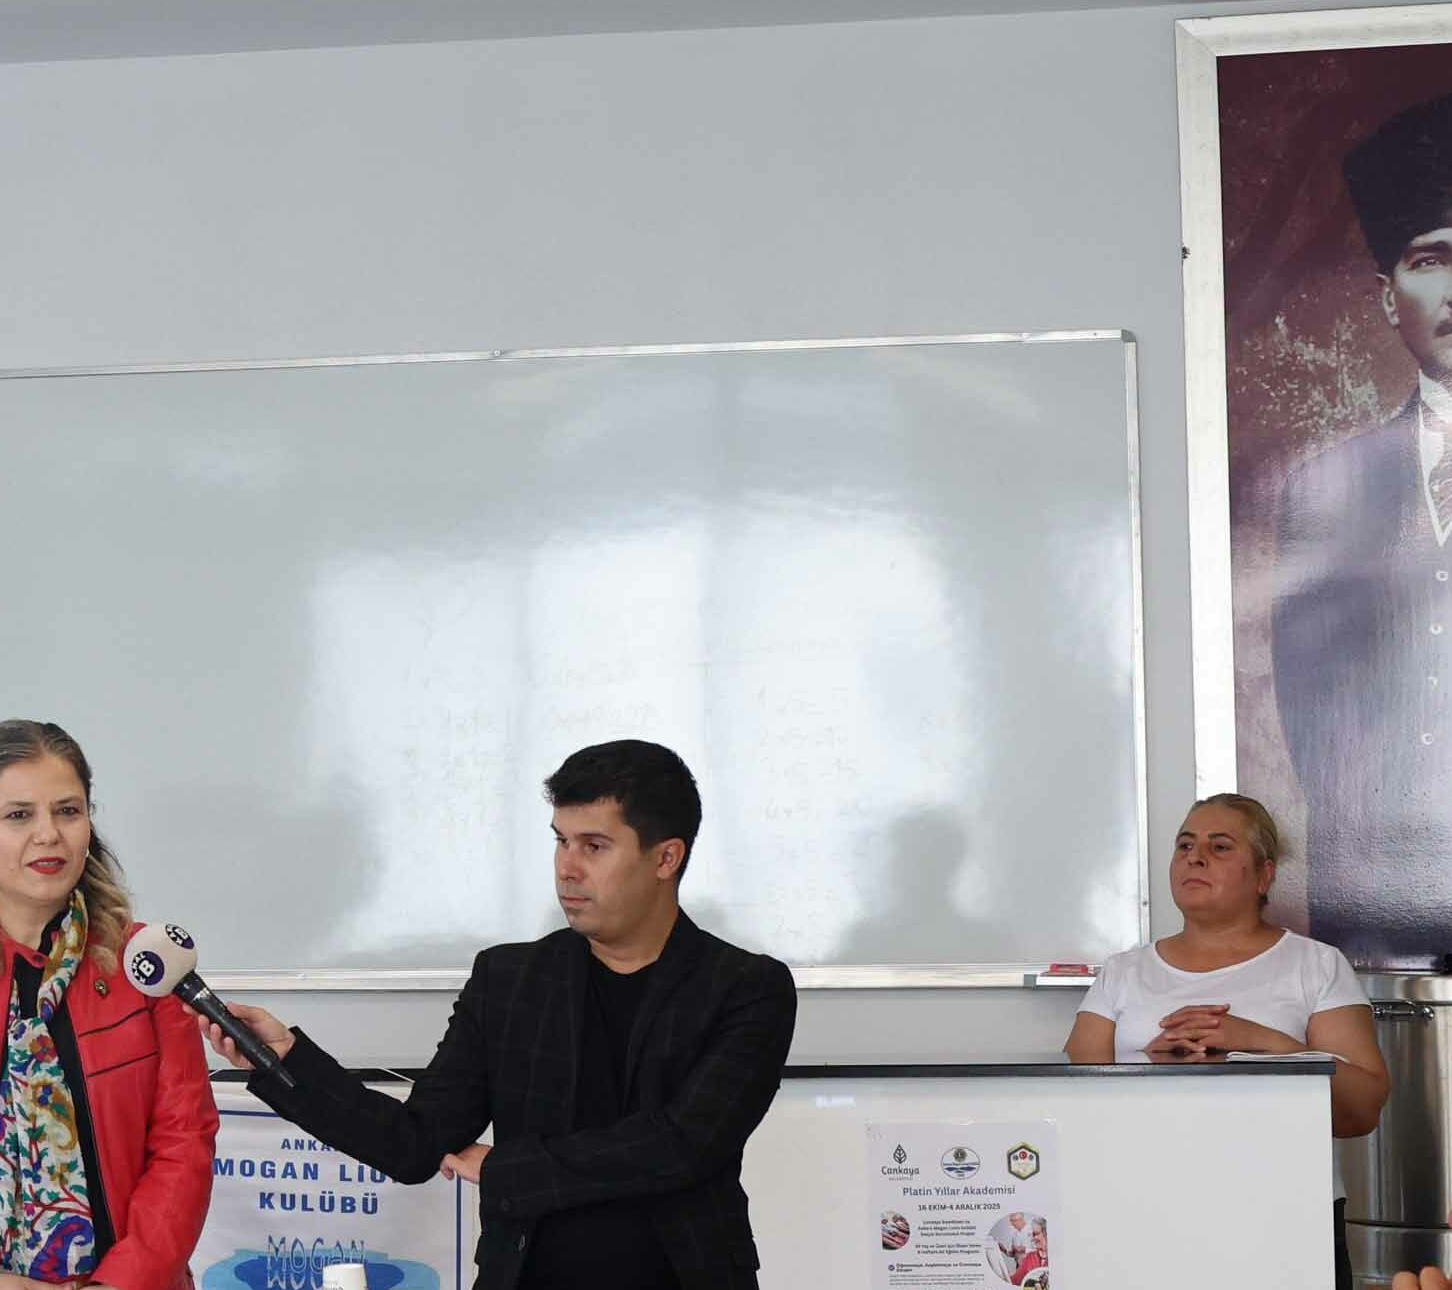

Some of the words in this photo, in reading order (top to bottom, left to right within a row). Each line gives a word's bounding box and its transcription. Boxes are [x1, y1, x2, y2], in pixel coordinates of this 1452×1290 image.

[138, 959, 156, 978] B
[280, 1138, 338, 1152] ANKA
[213, 1157, 319, 1181] MOGAN
[339, 1163, 396, 1184] LIO
[903, 1187, 932, 1196] Platin
[934, 1186, 961, 1196] Yıllar
[962, 1185, 1016, 1196] Akademisi
[259, 1190, 378, 1215] KULÜBÜ
